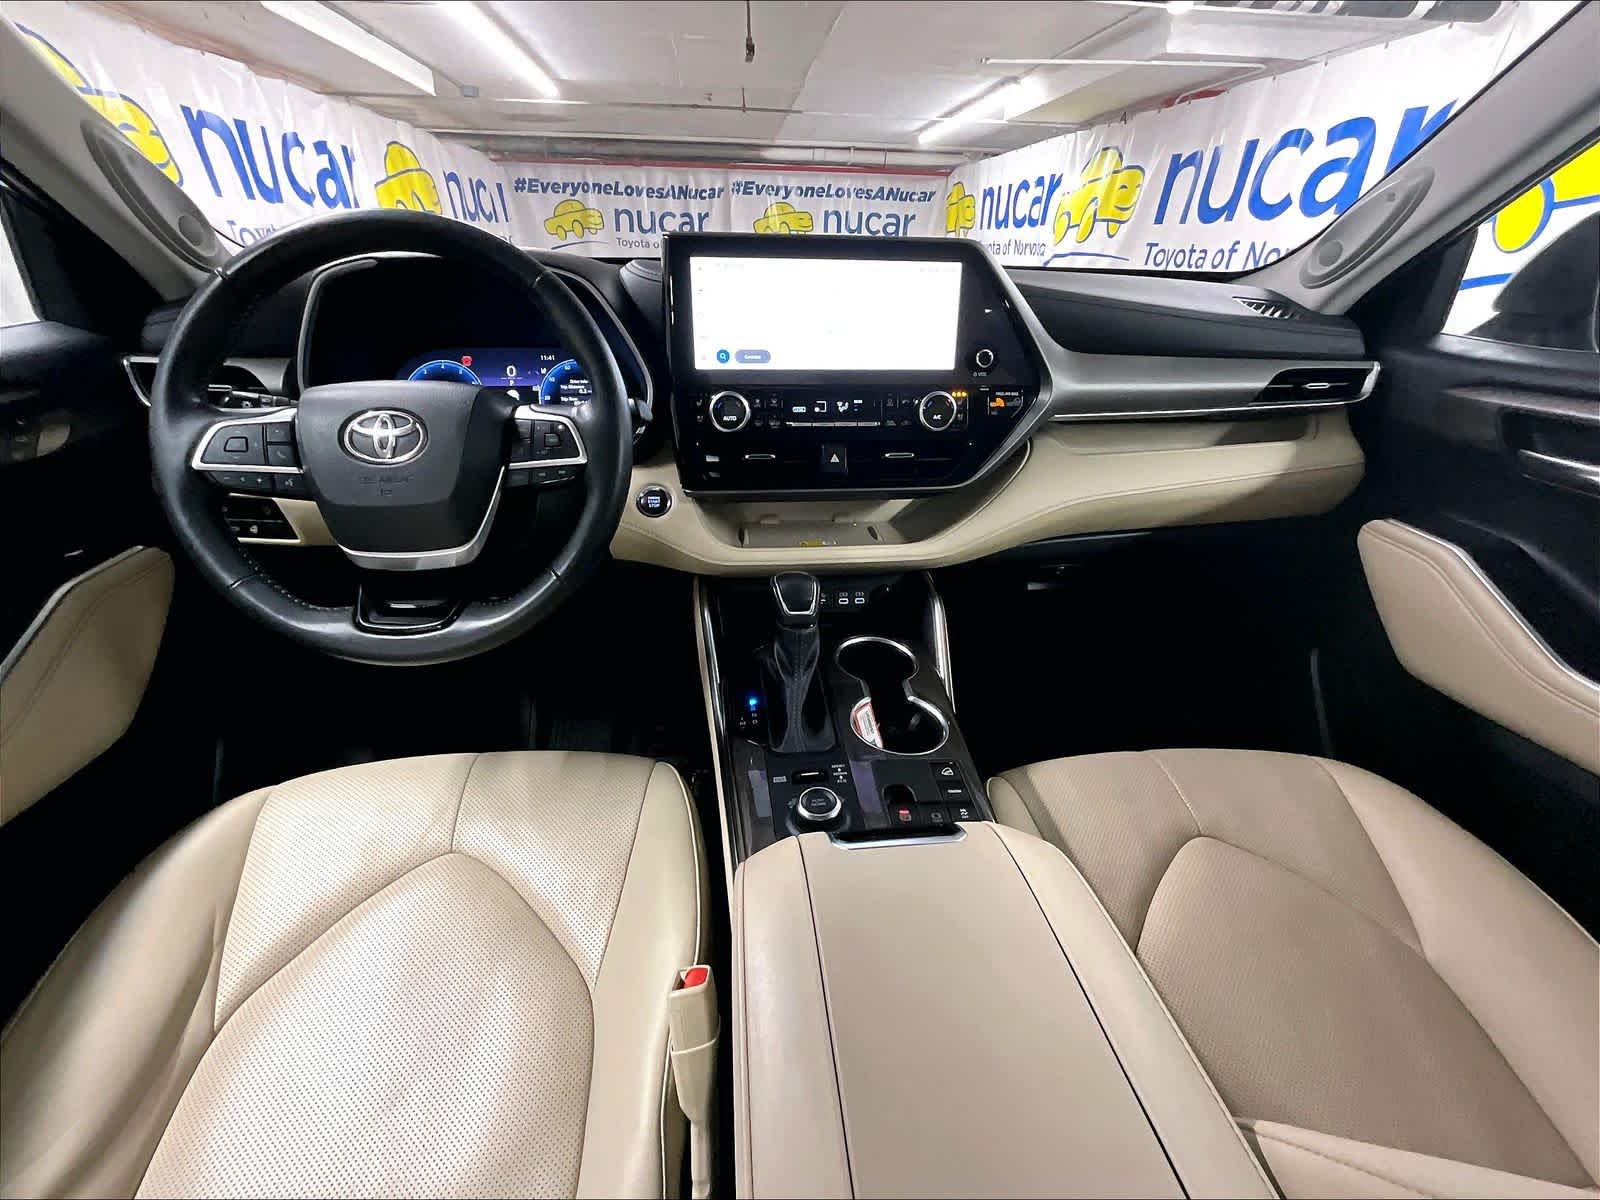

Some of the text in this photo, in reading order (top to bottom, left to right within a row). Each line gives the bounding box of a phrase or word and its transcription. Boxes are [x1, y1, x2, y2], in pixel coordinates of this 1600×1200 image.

[179, 104, 361, 210] nucar
[1153, 98, 1459, 226] nucar
[513, 177, 725, 201] #EveryoneLovesANucar
[731, 180, 937, 203] #EveryoneLovesANucar
[980, 172, 1064, 231] nucar
[613, 206, 710, 235] nucar
[822, 208, 917, 237] nucar
[616, 236, 651, 250] Toyota
[1144, 242, 1208, 270] Toyota
[1211, 240, 1241, 270] of
[506, 365, 517, 378] 0
